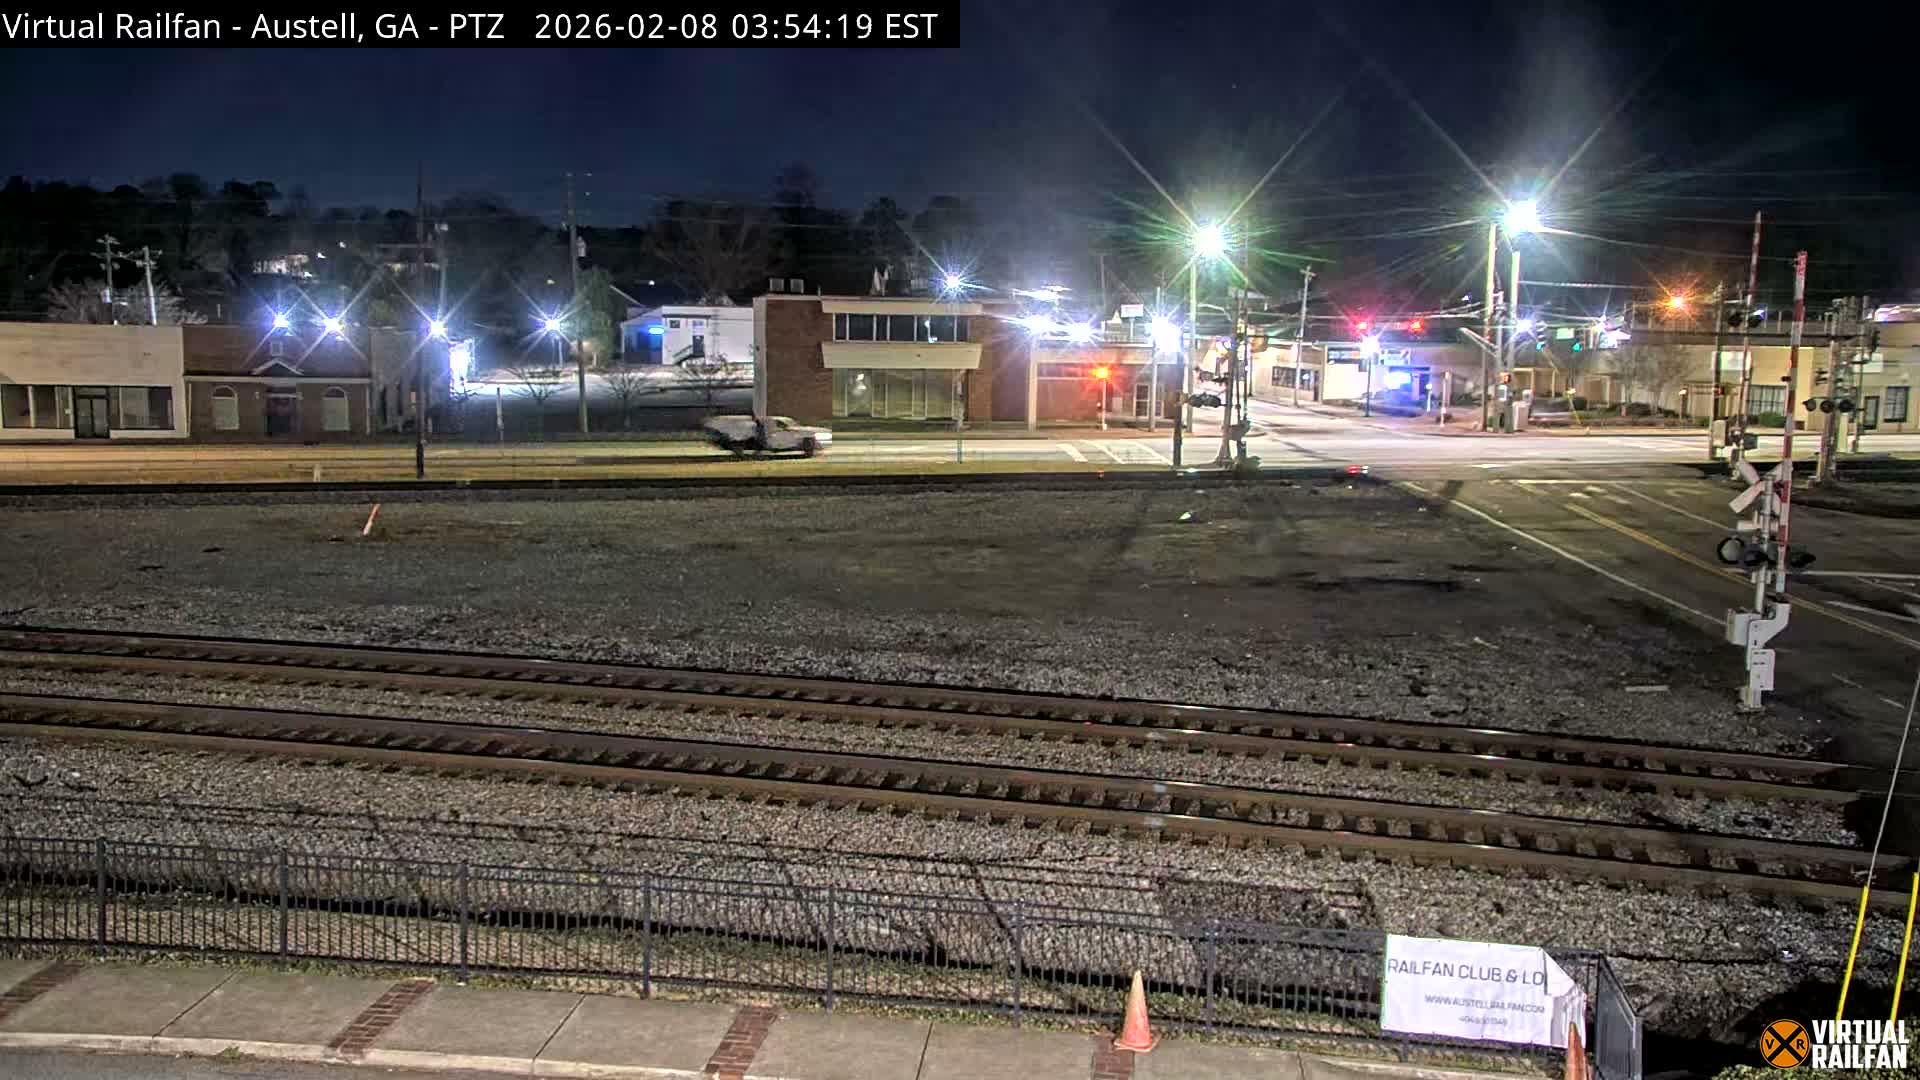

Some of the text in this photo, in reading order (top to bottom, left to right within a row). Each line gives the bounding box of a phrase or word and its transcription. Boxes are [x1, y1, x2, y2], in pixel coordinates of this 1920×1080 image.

[1388, 958, 1454, 977] RAILFAN
[1458, 964, 1502, 982] CLUB
[1505, 969, 1518, 983] &
